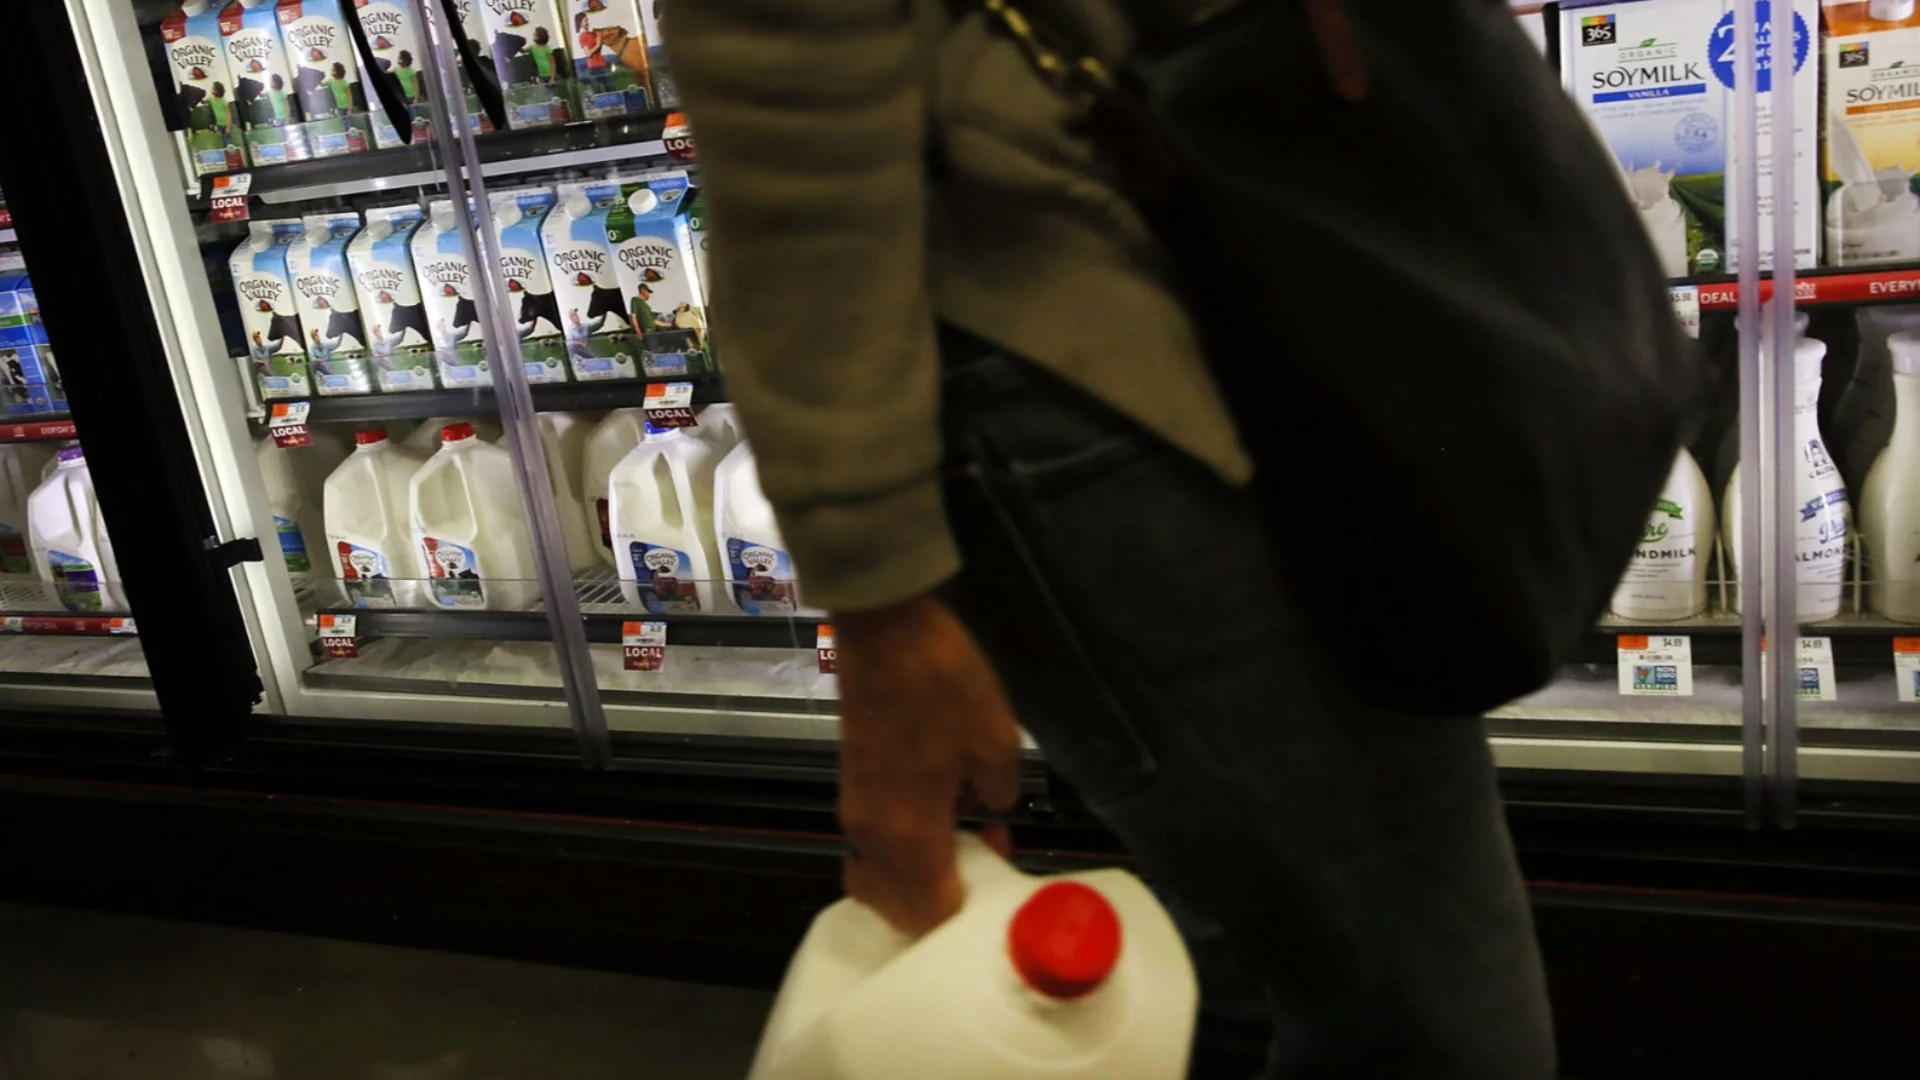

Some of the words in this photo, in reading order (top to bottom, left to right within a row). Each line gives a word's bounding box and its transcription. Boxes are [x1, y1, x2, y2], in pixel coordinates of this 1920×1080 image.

[361, 12, 404, 26] RGANIC
[287, 24, 336, 43] ORGANIC
[368, 24, 399, 37] ALLEY
[1586, 26, 1612, 41] 365
[229, 37, 274, 54] ORGANIC
[294, 36, 333, 51] VALLEY
[171, 44, 216, 61] ORGANIC
[235, 48, 271, 63] VALLEY
[1619, 47, 1676, 59] ORGANIC
[177, 56, 213, 70] VALLEY
[1592, 62, 1705, 89] SOYMILK
[1627, 89, 1670, 98] VANILLA
[1846, 82, 1920, 103] SOYMIL
[666, 138, 696, 150] LOC
[212, 197, 244, 209] LOCAL
[553, 249, 606, 267] ORGANIC
[618, 245, 673, 263] ORGANIC
[500, 256, 535, 269] GANIC
[560, 261, 602, 275] VALLEY
[625, 257, 670, 272] VALLEY
[422, 262, 469, 277] ORGANIC
[503, 268, 532, 280] ALLEY
[297, 276, 340, 290] ORGANIC
[358, 269, 403, 285] ORGANIC
[428, 273, 466, 286] VALLEY
[240, 279, 282, 293] ORGANIC
[302, 287, 338, 298] VALLEY
[364, 280, 400, 292] VALLEY
[1869, 279, 1920, 293] EVERY
[245, 290, 280, 301] VALLEY
[1700, 292, 1737, 304] DEAL
[648, 409, 690, 419] LOCAL
[272, 426, 306, 437] LOCAL
[646, 552, 676, 562] ORGANIC
[743, 550, 776, 560] ORGANIC
[1636, 546, 1697, 559] NDMILK
[651, 558, 675, 566] VALLEY
[747, 557, 772, 565] VALLEY
[322, 638, 354, 647] LOCAL
[625, 647, 662, 658] LOCAL
